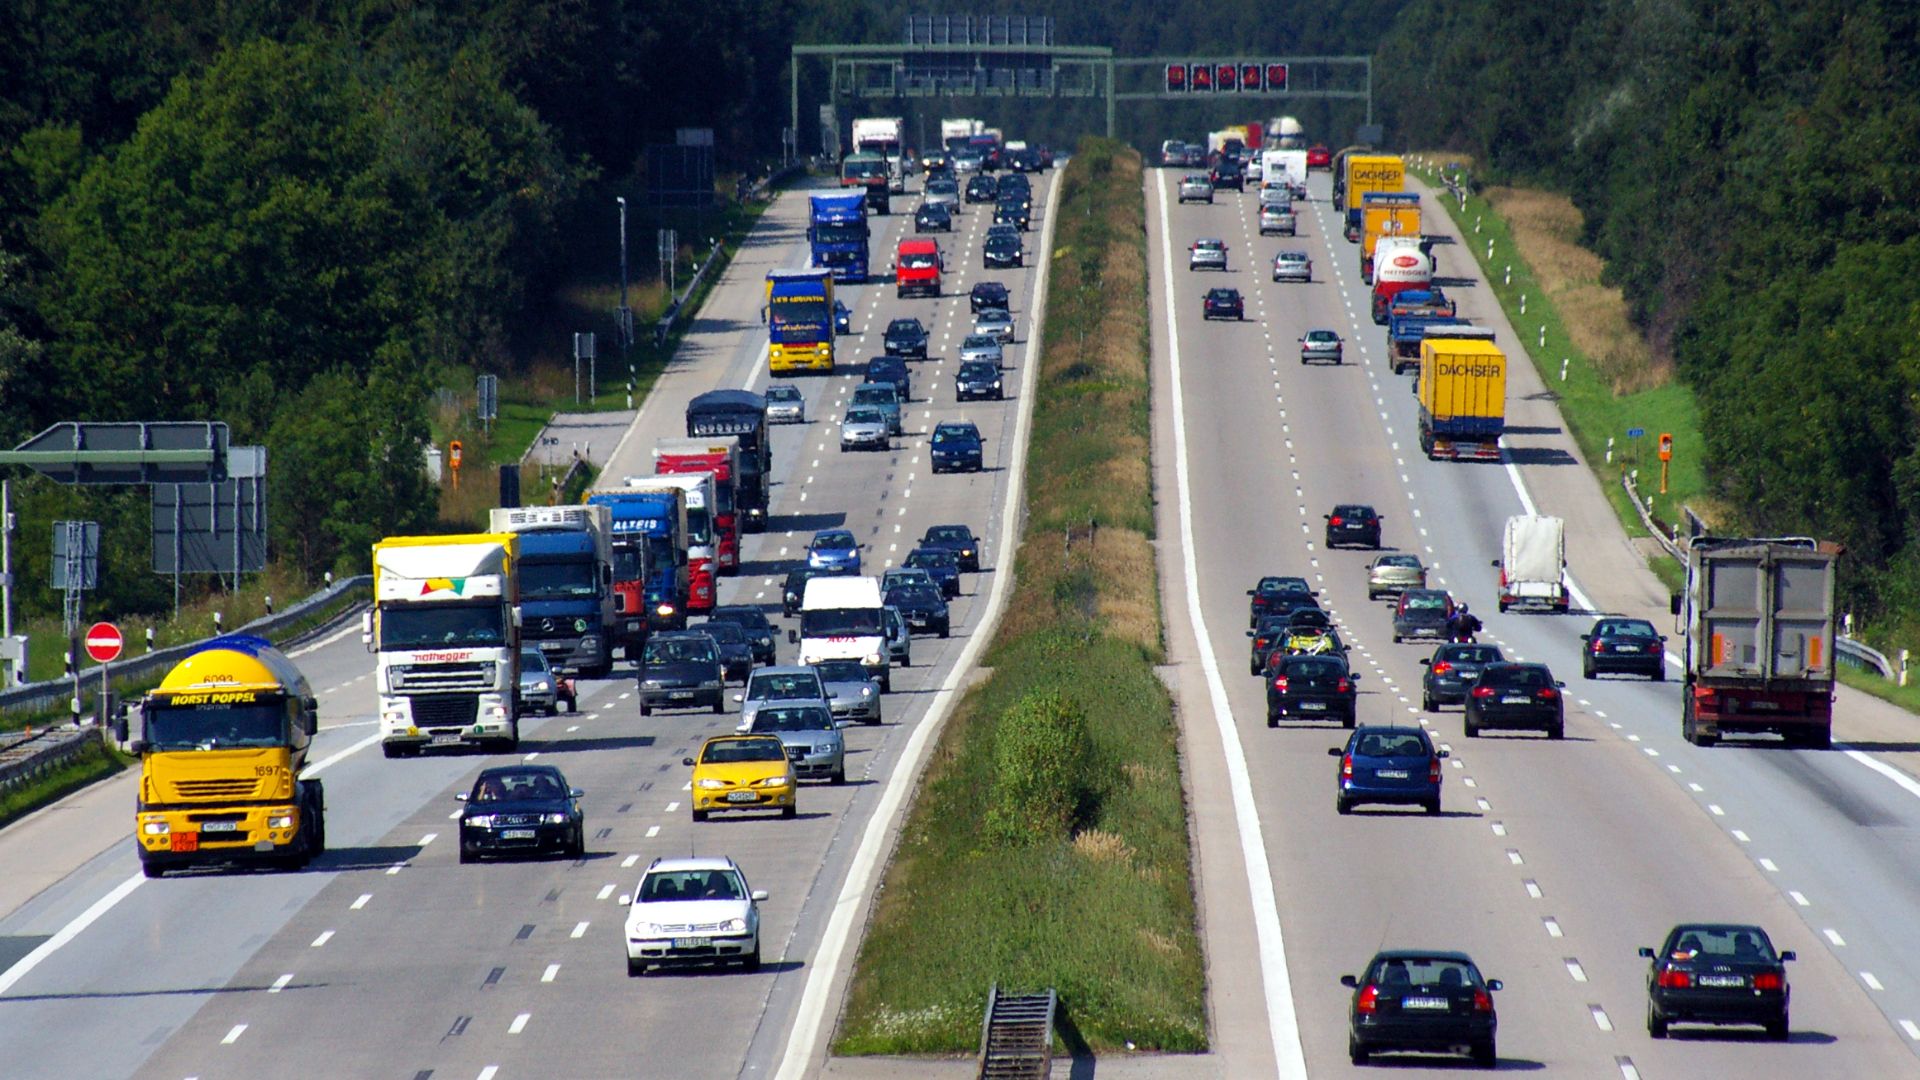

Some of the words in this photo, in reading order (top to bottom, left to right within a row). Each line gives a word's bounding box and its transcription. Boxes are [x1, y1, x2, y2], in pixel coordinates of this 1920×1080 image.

[1439, 363, 1500, 378] DACHSER
[171, 694, 209, 706] HORST
[254, 766, 280, 777] 1697
